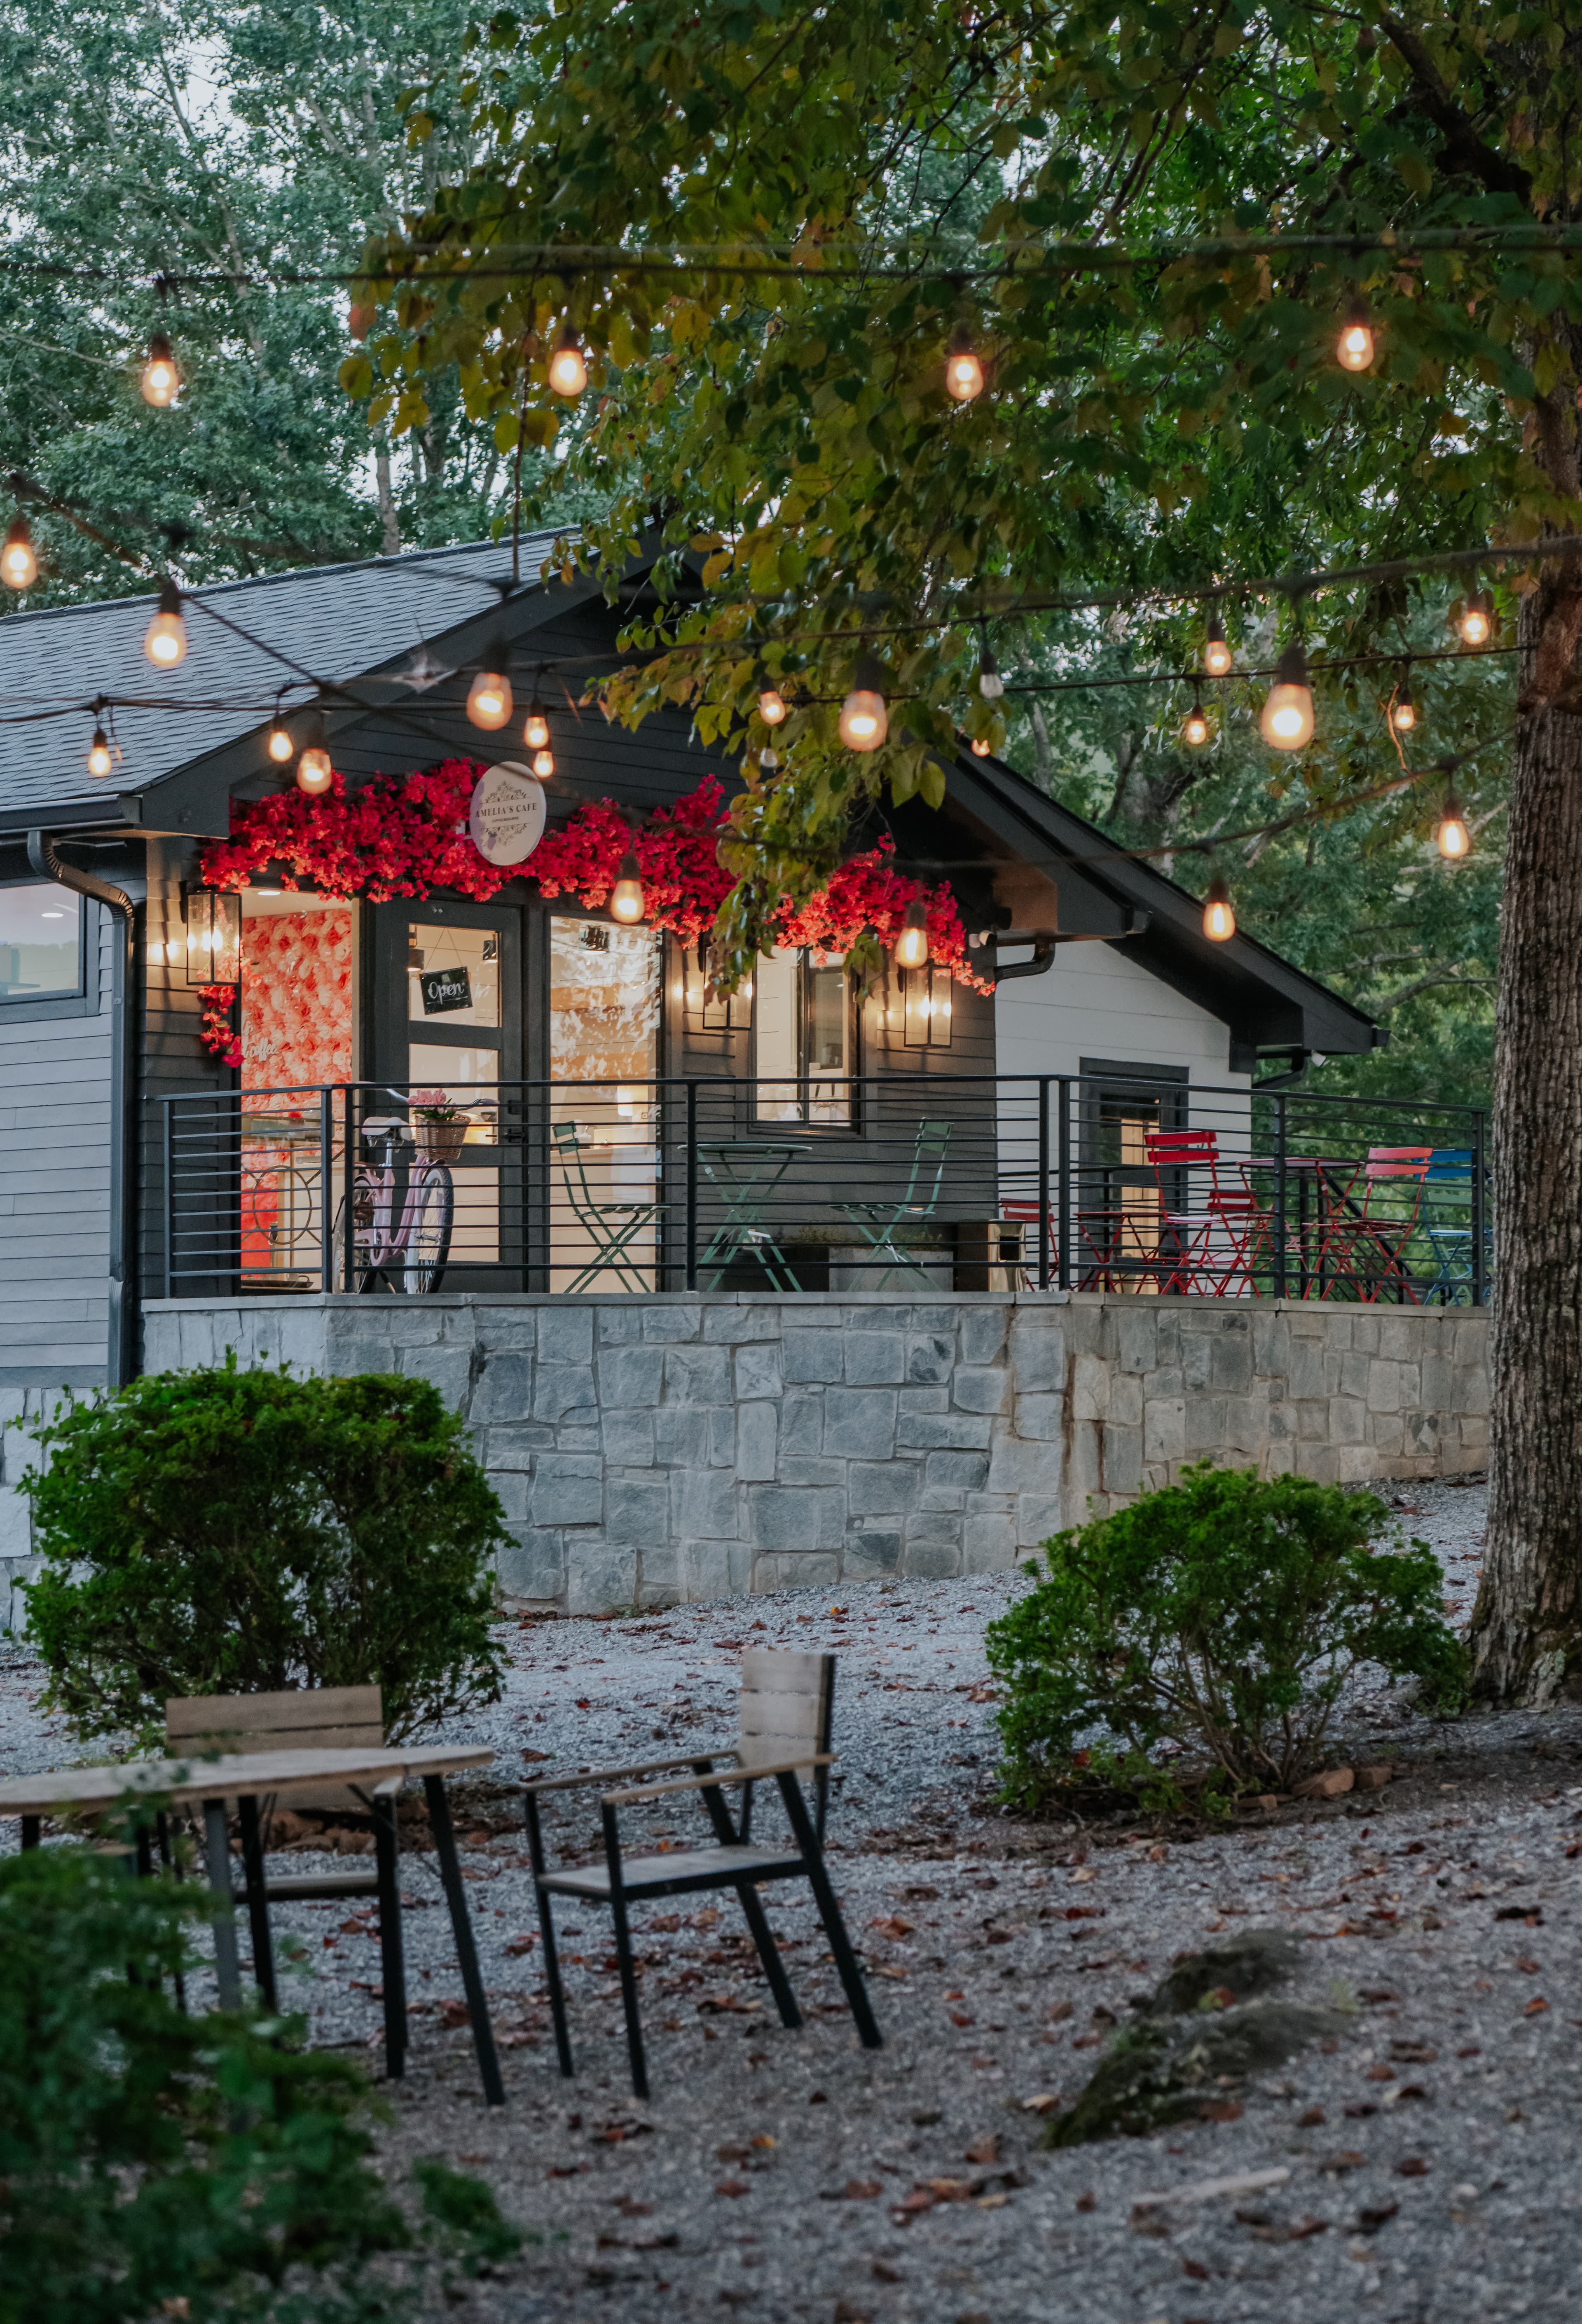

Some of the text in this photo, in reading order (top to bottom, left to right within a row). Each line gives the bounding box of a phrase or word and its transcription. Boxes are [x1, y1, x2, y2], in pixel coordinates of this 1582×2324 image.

[475, 802, 537, 818] AMELIA'S CAFE
[427, 982, 465, 1005] Open
